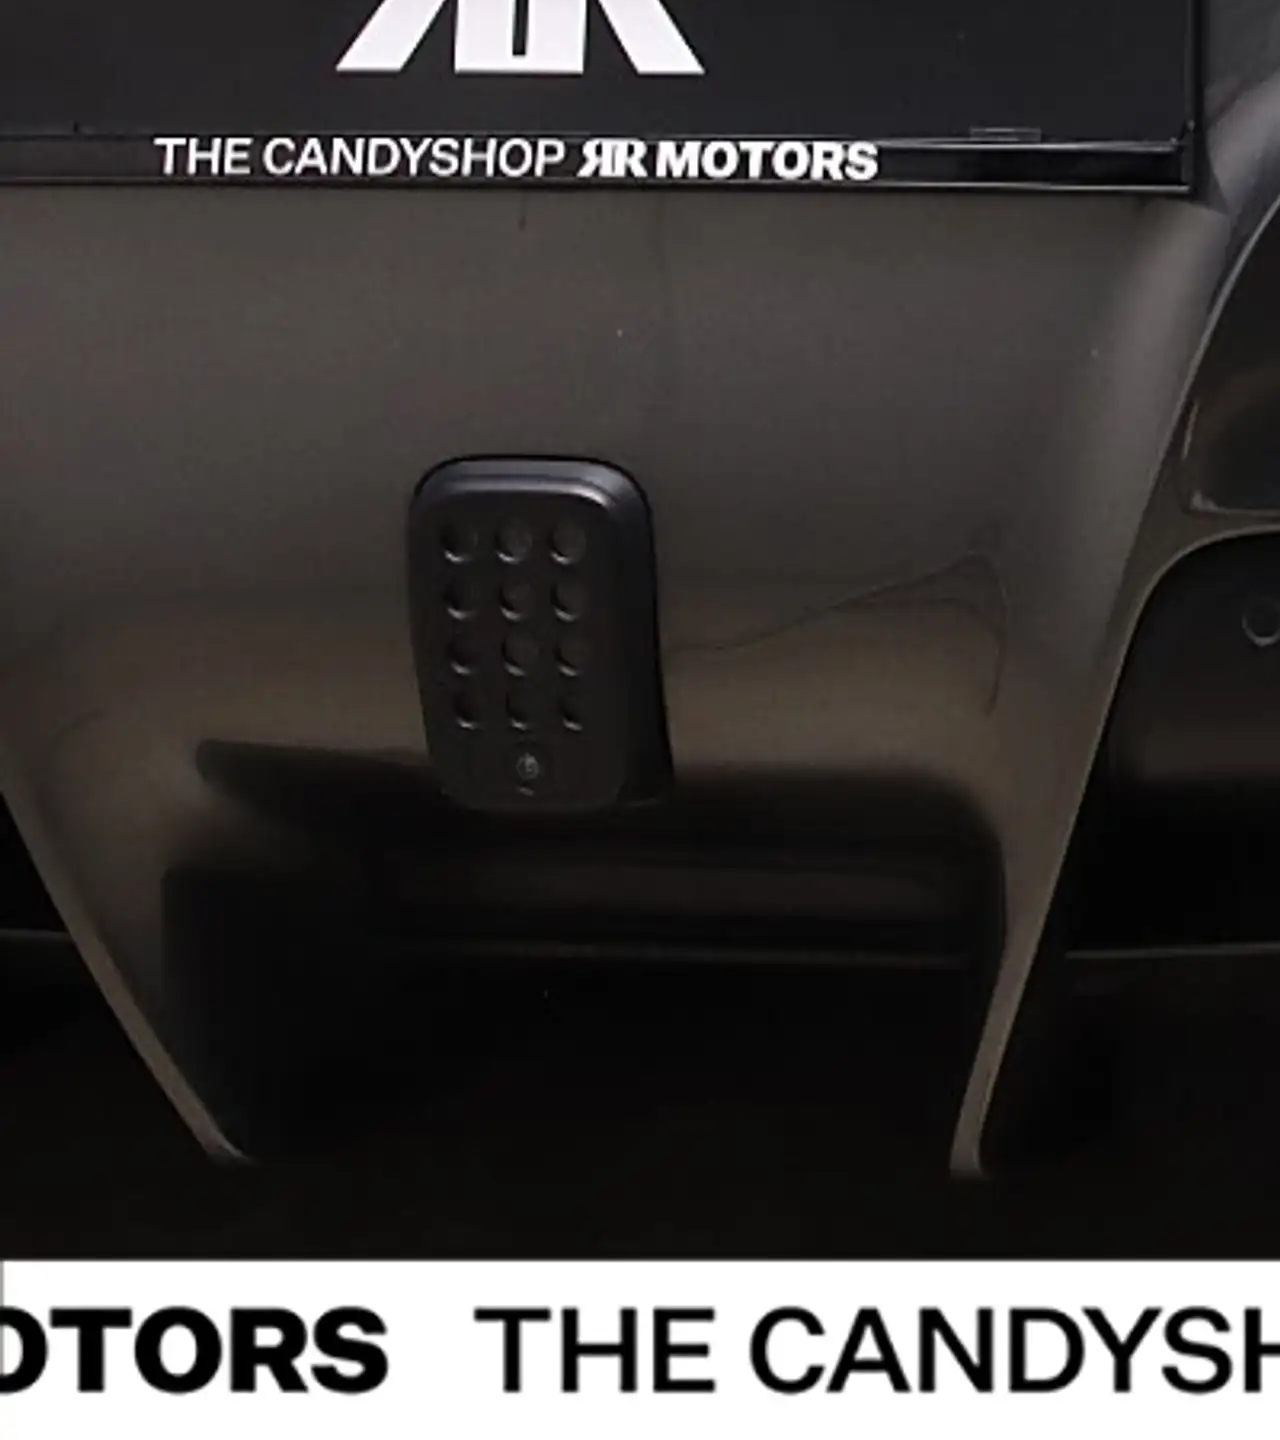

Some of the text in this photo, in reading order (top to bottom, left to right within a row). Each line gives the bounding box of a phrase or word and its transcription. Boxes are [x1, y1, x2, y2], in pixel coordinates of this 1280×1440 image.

[154, 137, 253, 176] THE
[263, 137, 566, 178] CANDYSHOP
[655, 140, 879, 181] MOTORS
